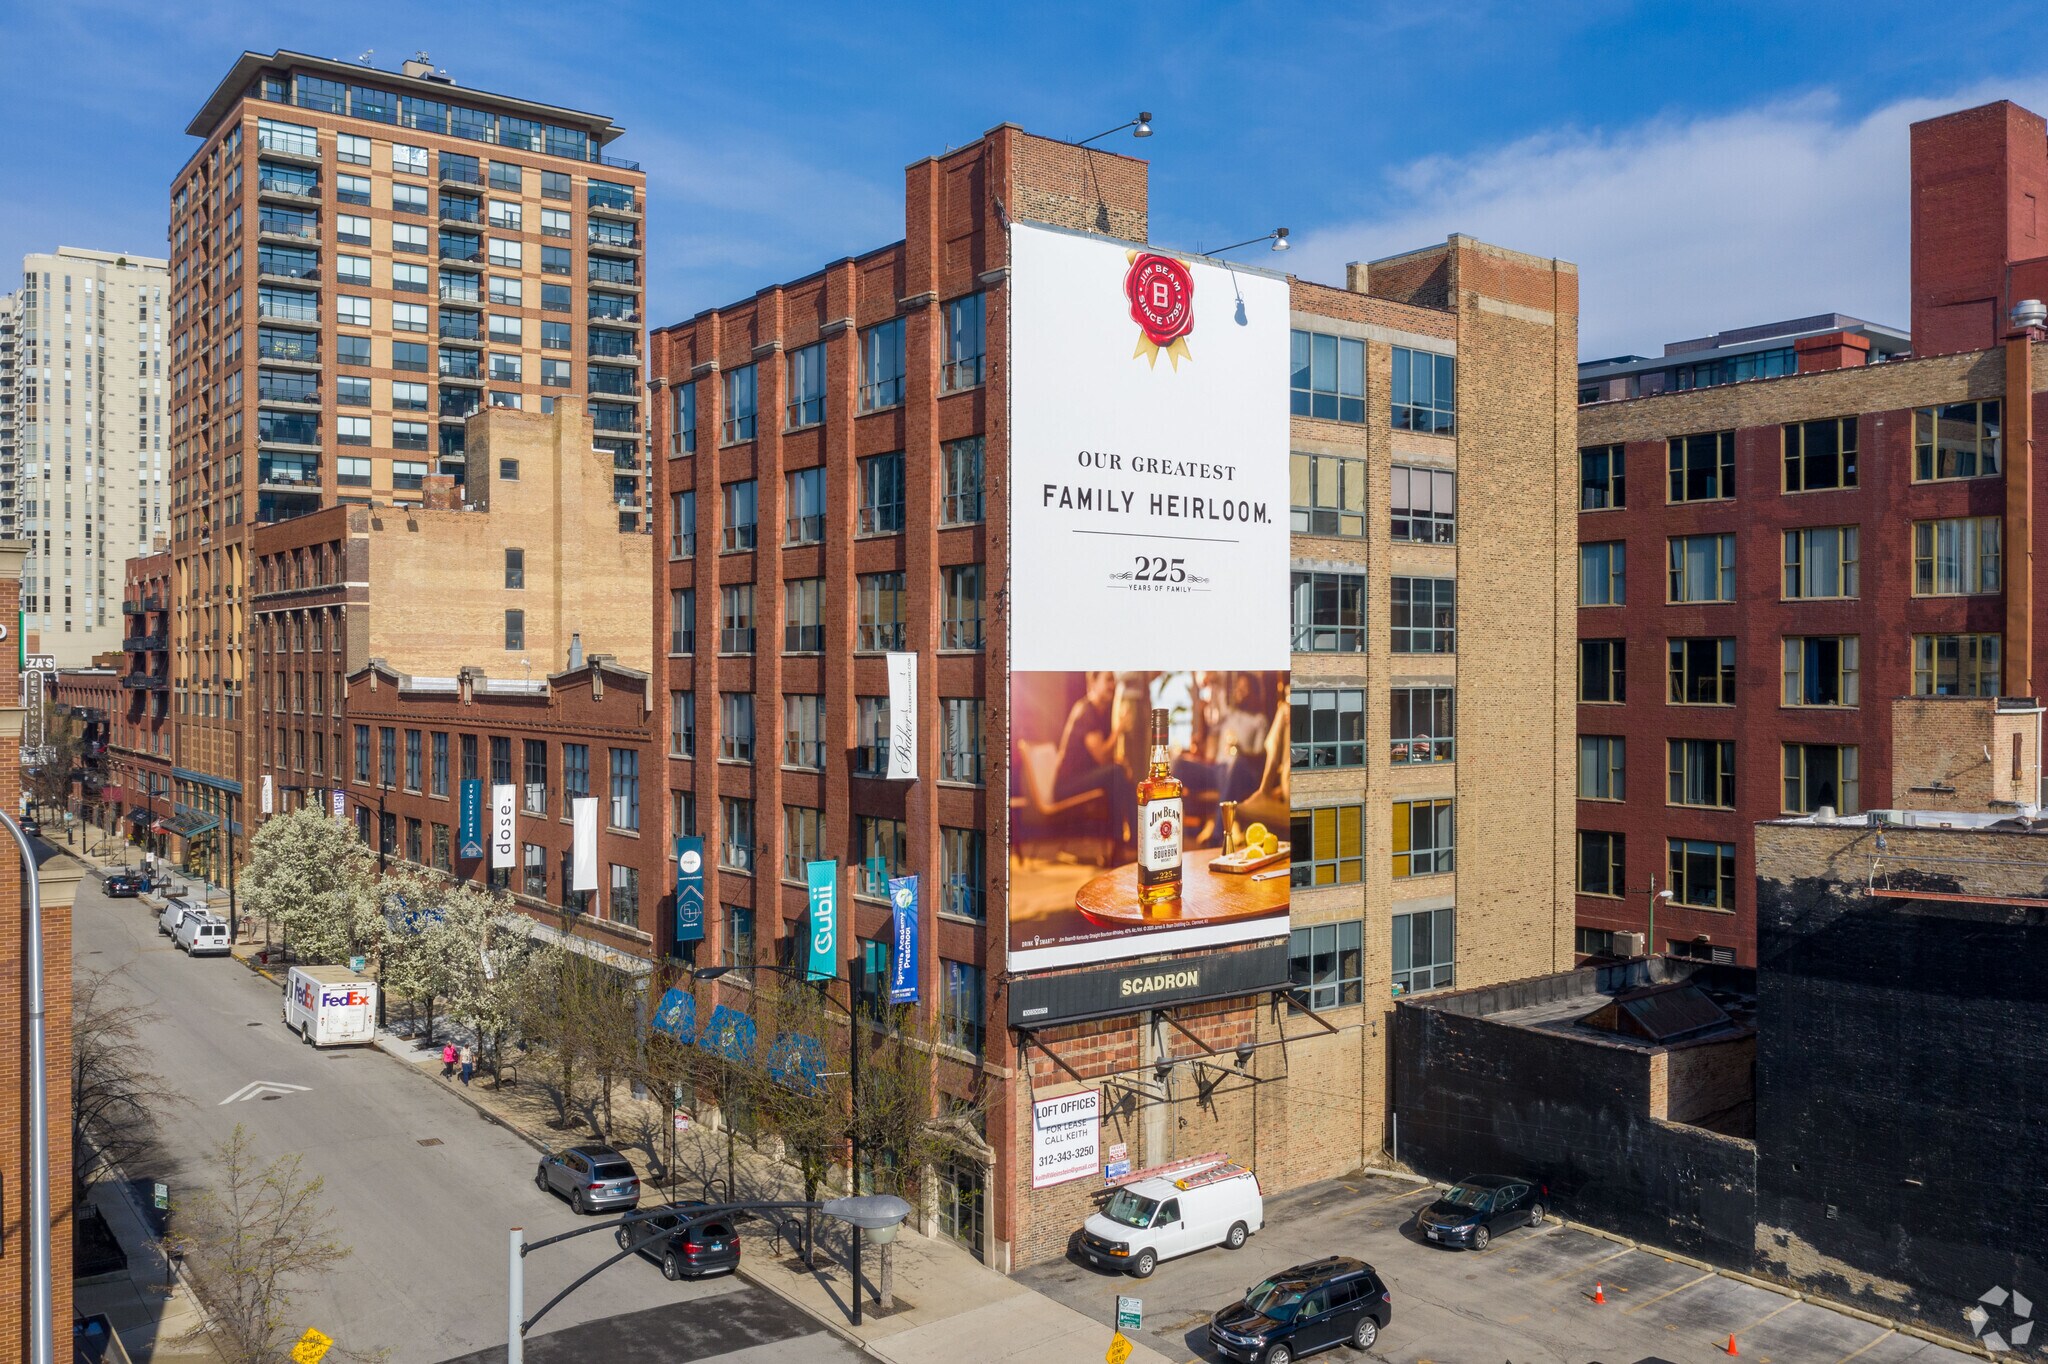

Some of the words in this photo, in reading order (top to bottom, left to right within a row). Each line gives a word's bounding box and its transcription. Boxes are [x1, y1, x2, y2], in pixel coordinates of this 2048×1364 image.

[1140, 267, 1152, 284] JIM
[1156, 264, 1181, 291] BEAM
[1153, 282, 1168, 308] B
[1139, 295, 1162, 324] SINCE
[1166, 302, 1182, 324] 1795
[1078, 450, 1122, 470] OUR
[1132, 456, 1236, 481] GREATEST
[1043, 484, 1134, 514] FAMILY
[1150, 493, 1272, 524] HEIRLOOM.
[1134, 556, 1186, 584] 225
[1129, 584, 1151, 592] YEARS
[1154, 584, 1164, 592] OF
[1166, 585, 1192, 593] FAMILY
[893, 716, 912, 774] Baker
[496, 798, 511, 854] dose.
[1150, 810, 1162, 827] JIM
[1164, 806, 1180, 822] BEAM
[1154, 848, 1177, 859] BOURBON
[812, 880, 832, 954] Cubii
[896, 952, 904, 986] Sprouts
[294, 976, 314, 1011] FedEx
[1122, 970, 1198, 996] SCADRON
[322, 992, 369, 1007] FedEx
[1036, 1104, 1058, 1118] LOFT
[1060, 1097, 1096, 1114] OFFICES
[1045, 1134, 1064, 1145] CALL
[1066, 1129, 1088, 1140] KEITH
[1046, 1123, 1062, 1134] FOR
[1064, 1119, 1087, 1131] LEASE
[1039, 1145, 1094, 1167] 312-343-3250
[1112, 1340, 1125, 1349] SPEED
[1112, 1347, 1124, 1356] HUMP
[1112, 1354, 1125, 1363] AHEAD
